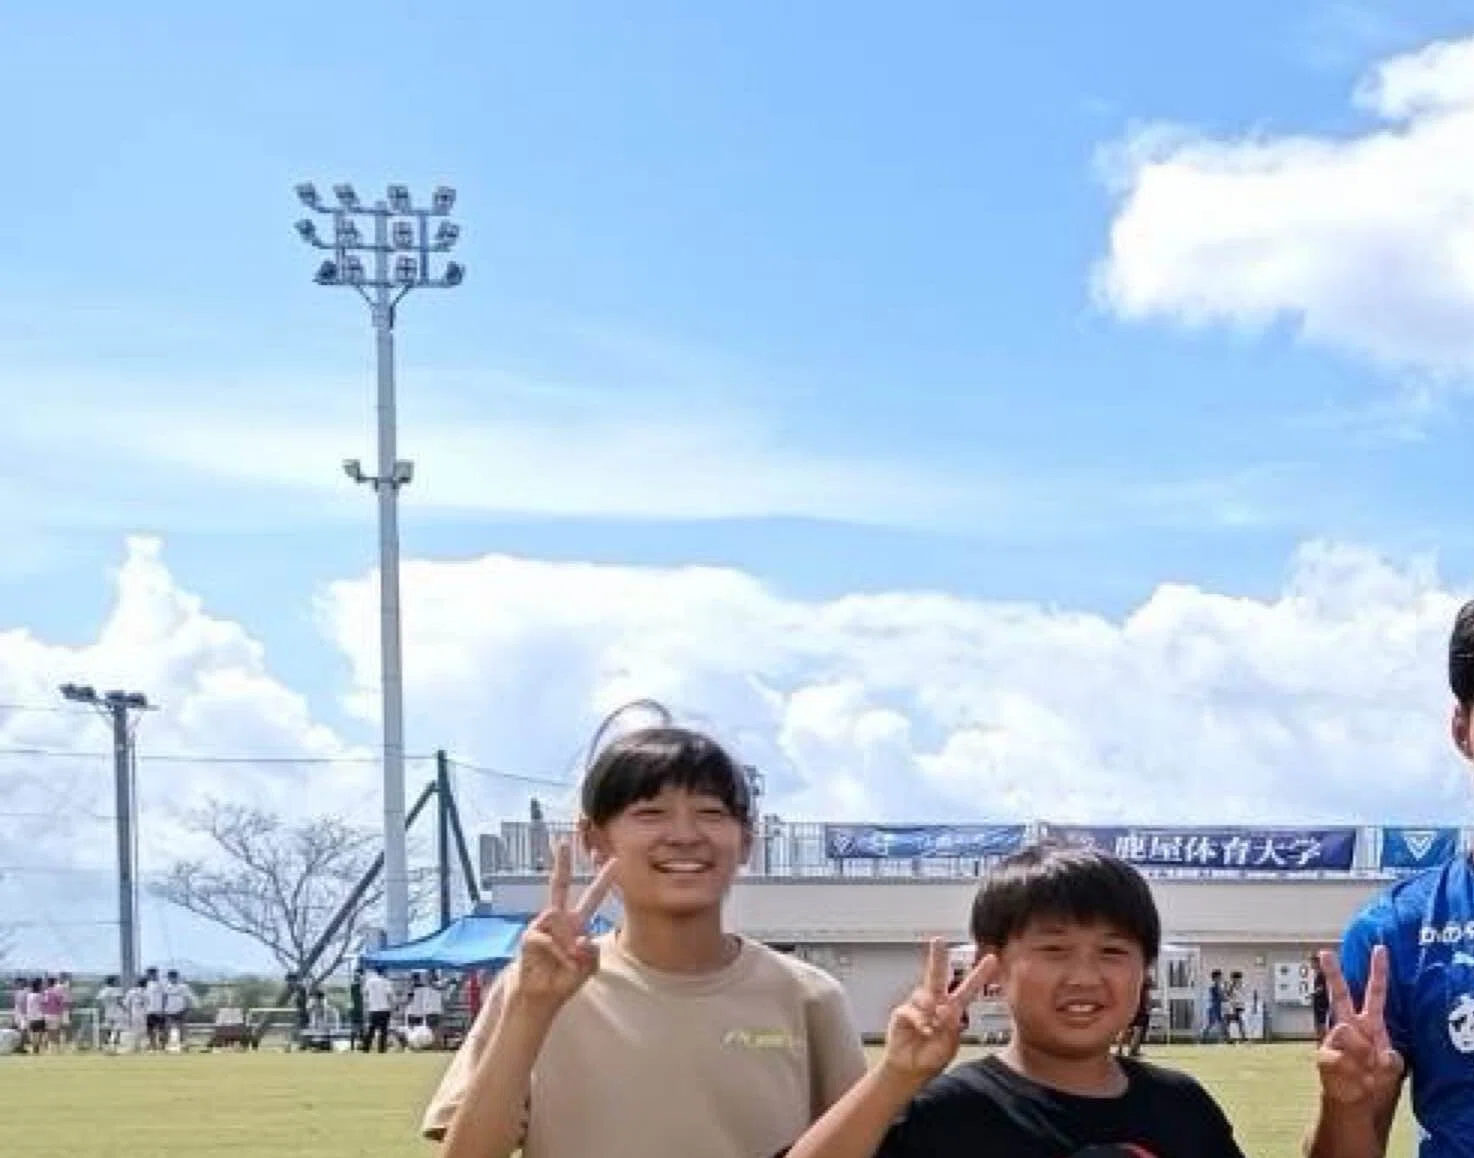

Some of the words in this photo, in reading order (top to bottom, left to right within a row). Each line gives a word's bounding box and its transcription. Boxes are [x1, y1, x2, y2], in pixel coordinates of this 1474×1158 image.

[1114, 833, 1322, 866] 鹿屋体育大学
